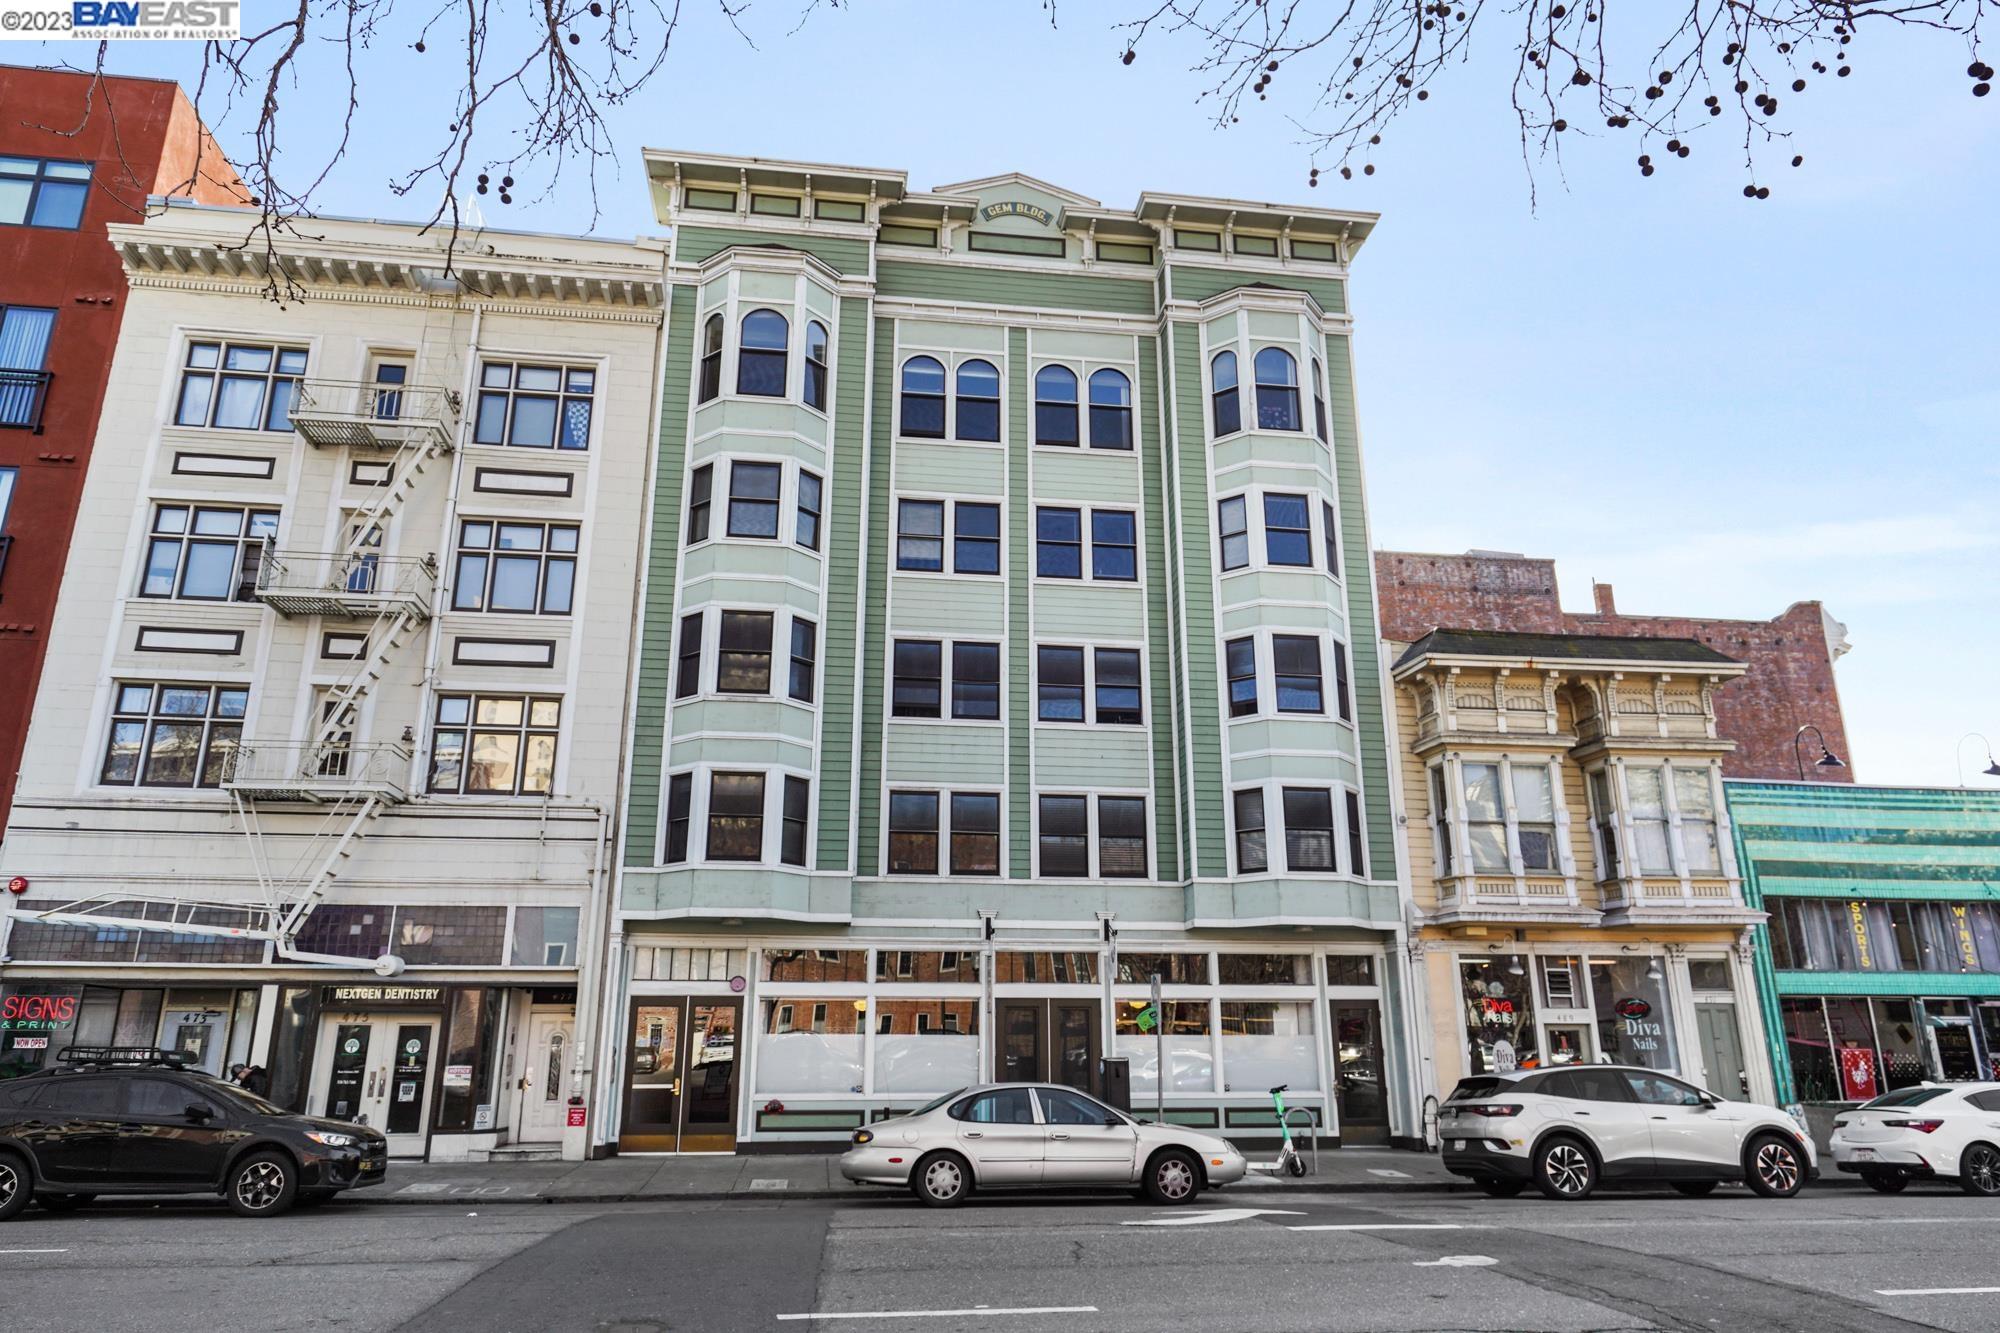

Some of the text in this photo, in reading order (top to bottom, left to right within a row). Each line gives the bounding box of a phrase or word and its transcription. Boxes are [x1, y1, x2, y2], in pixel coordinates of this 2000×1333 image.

[988, 203, 1012, 216] GEM
[1851, 902, 1870, 967] SPORTS
[1952, 907, 1976, 965] WINGS
[335, 988, 439, 999] NEXTGEN DENTISTRY
[2, 996, 75, 1019] SIGNS
[1481, 998, 1513, 1012] Diva
[1, 1021, 70, 1029] & PRINT
[183, 1013, 207, 1024] 473
[1625, 1020, 1661, 1036] Diva
[16, 1038, 46, 1048] NOW OPEN
[1633, 1038, 1658, 1050] Nails
[1496, 1049, 1515, 1064] Diva
